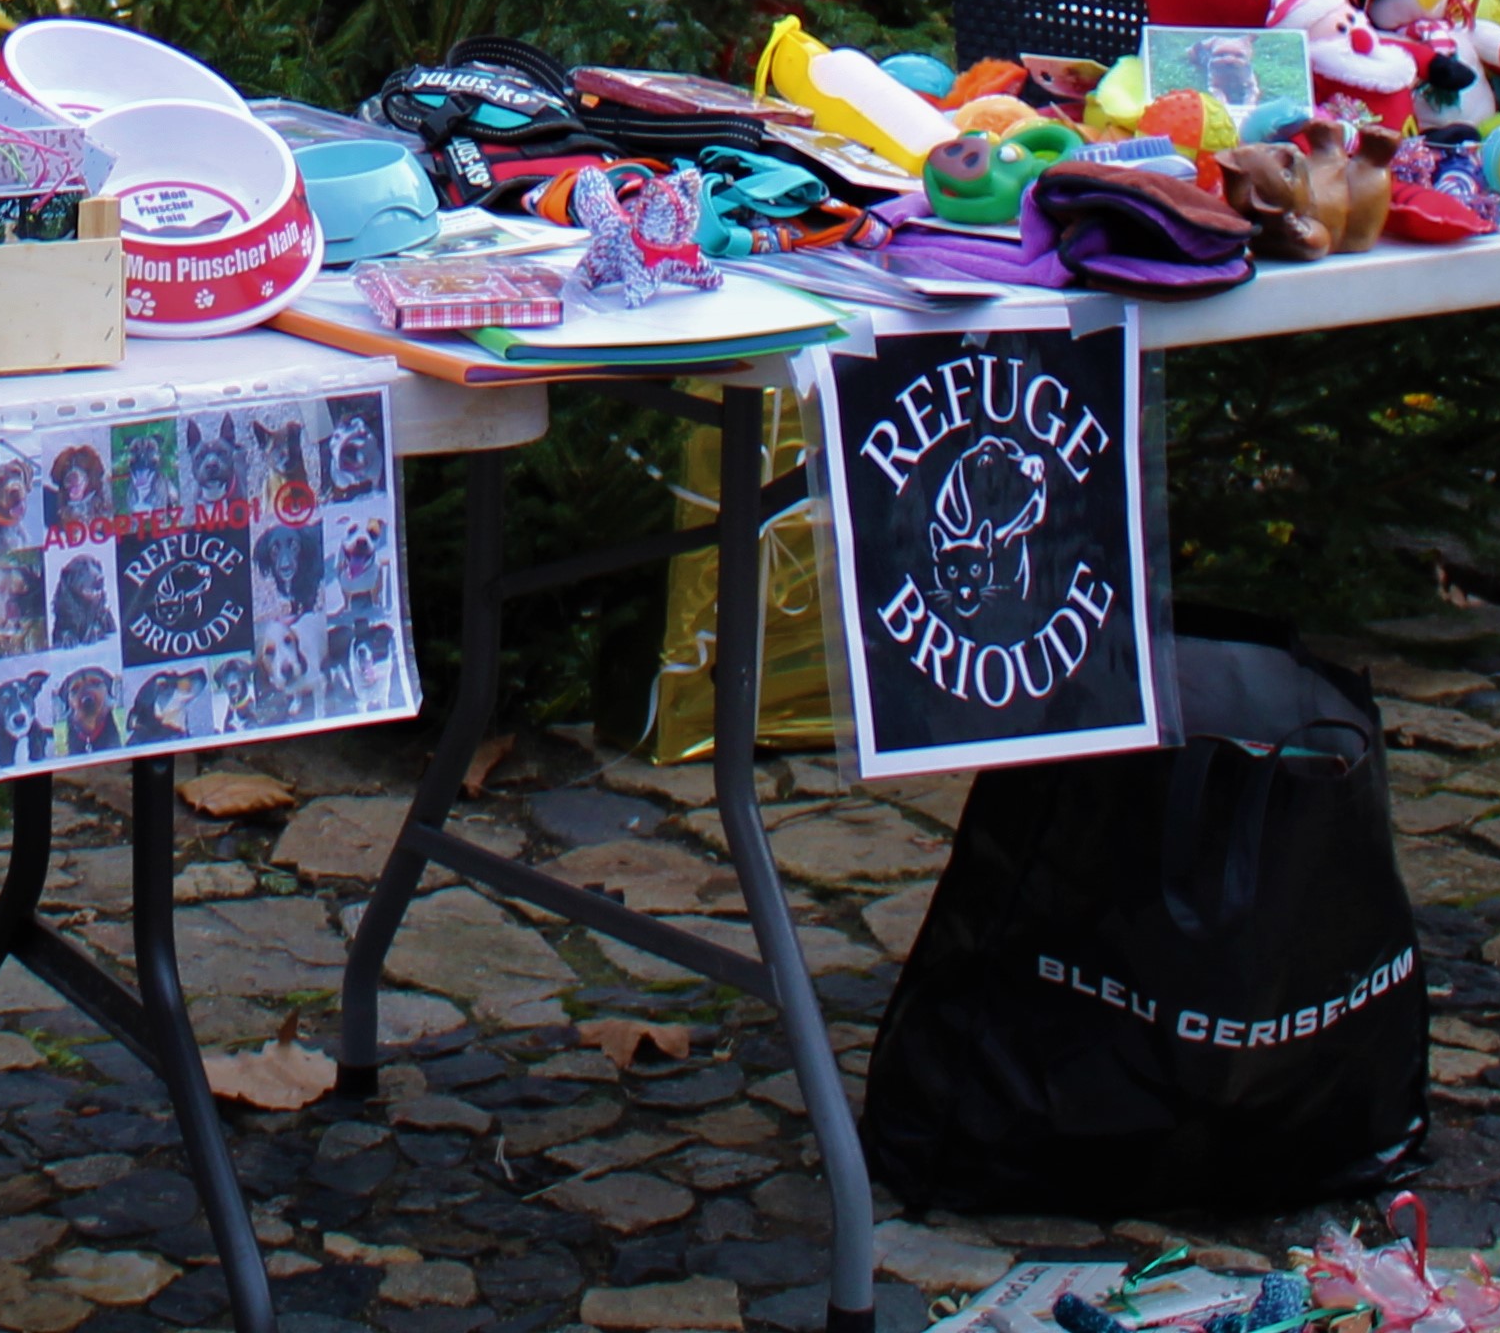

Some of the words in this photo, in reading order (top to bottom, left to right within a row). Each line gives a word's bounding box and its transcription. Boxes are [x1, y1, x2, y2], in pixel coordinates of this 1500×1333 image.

[137, 199, 194, 215] Pinscher
[156, 213, 186, 224] Nain
[159, 189, 187, 200] Mon
[126, 253, 171, 283] Mon
[176, 239, 265, 283] Pinscher
[265, 222, 300, 265] Nain
[861, 355, 1109, 495] REFUGE
[42, 507, 185, 552] ADOPTEZ
[195, 500, 261, 532] MOI
[124, 532, 245, 588] REFUGE
[129, 599, 245, 657] BRIOUDE
[878, 562, 1114, 708] BRIOUDE
[1037, 955, 1157, 1023] BLEU
[1176, 948, 1415, 1049] CERISE.COM
